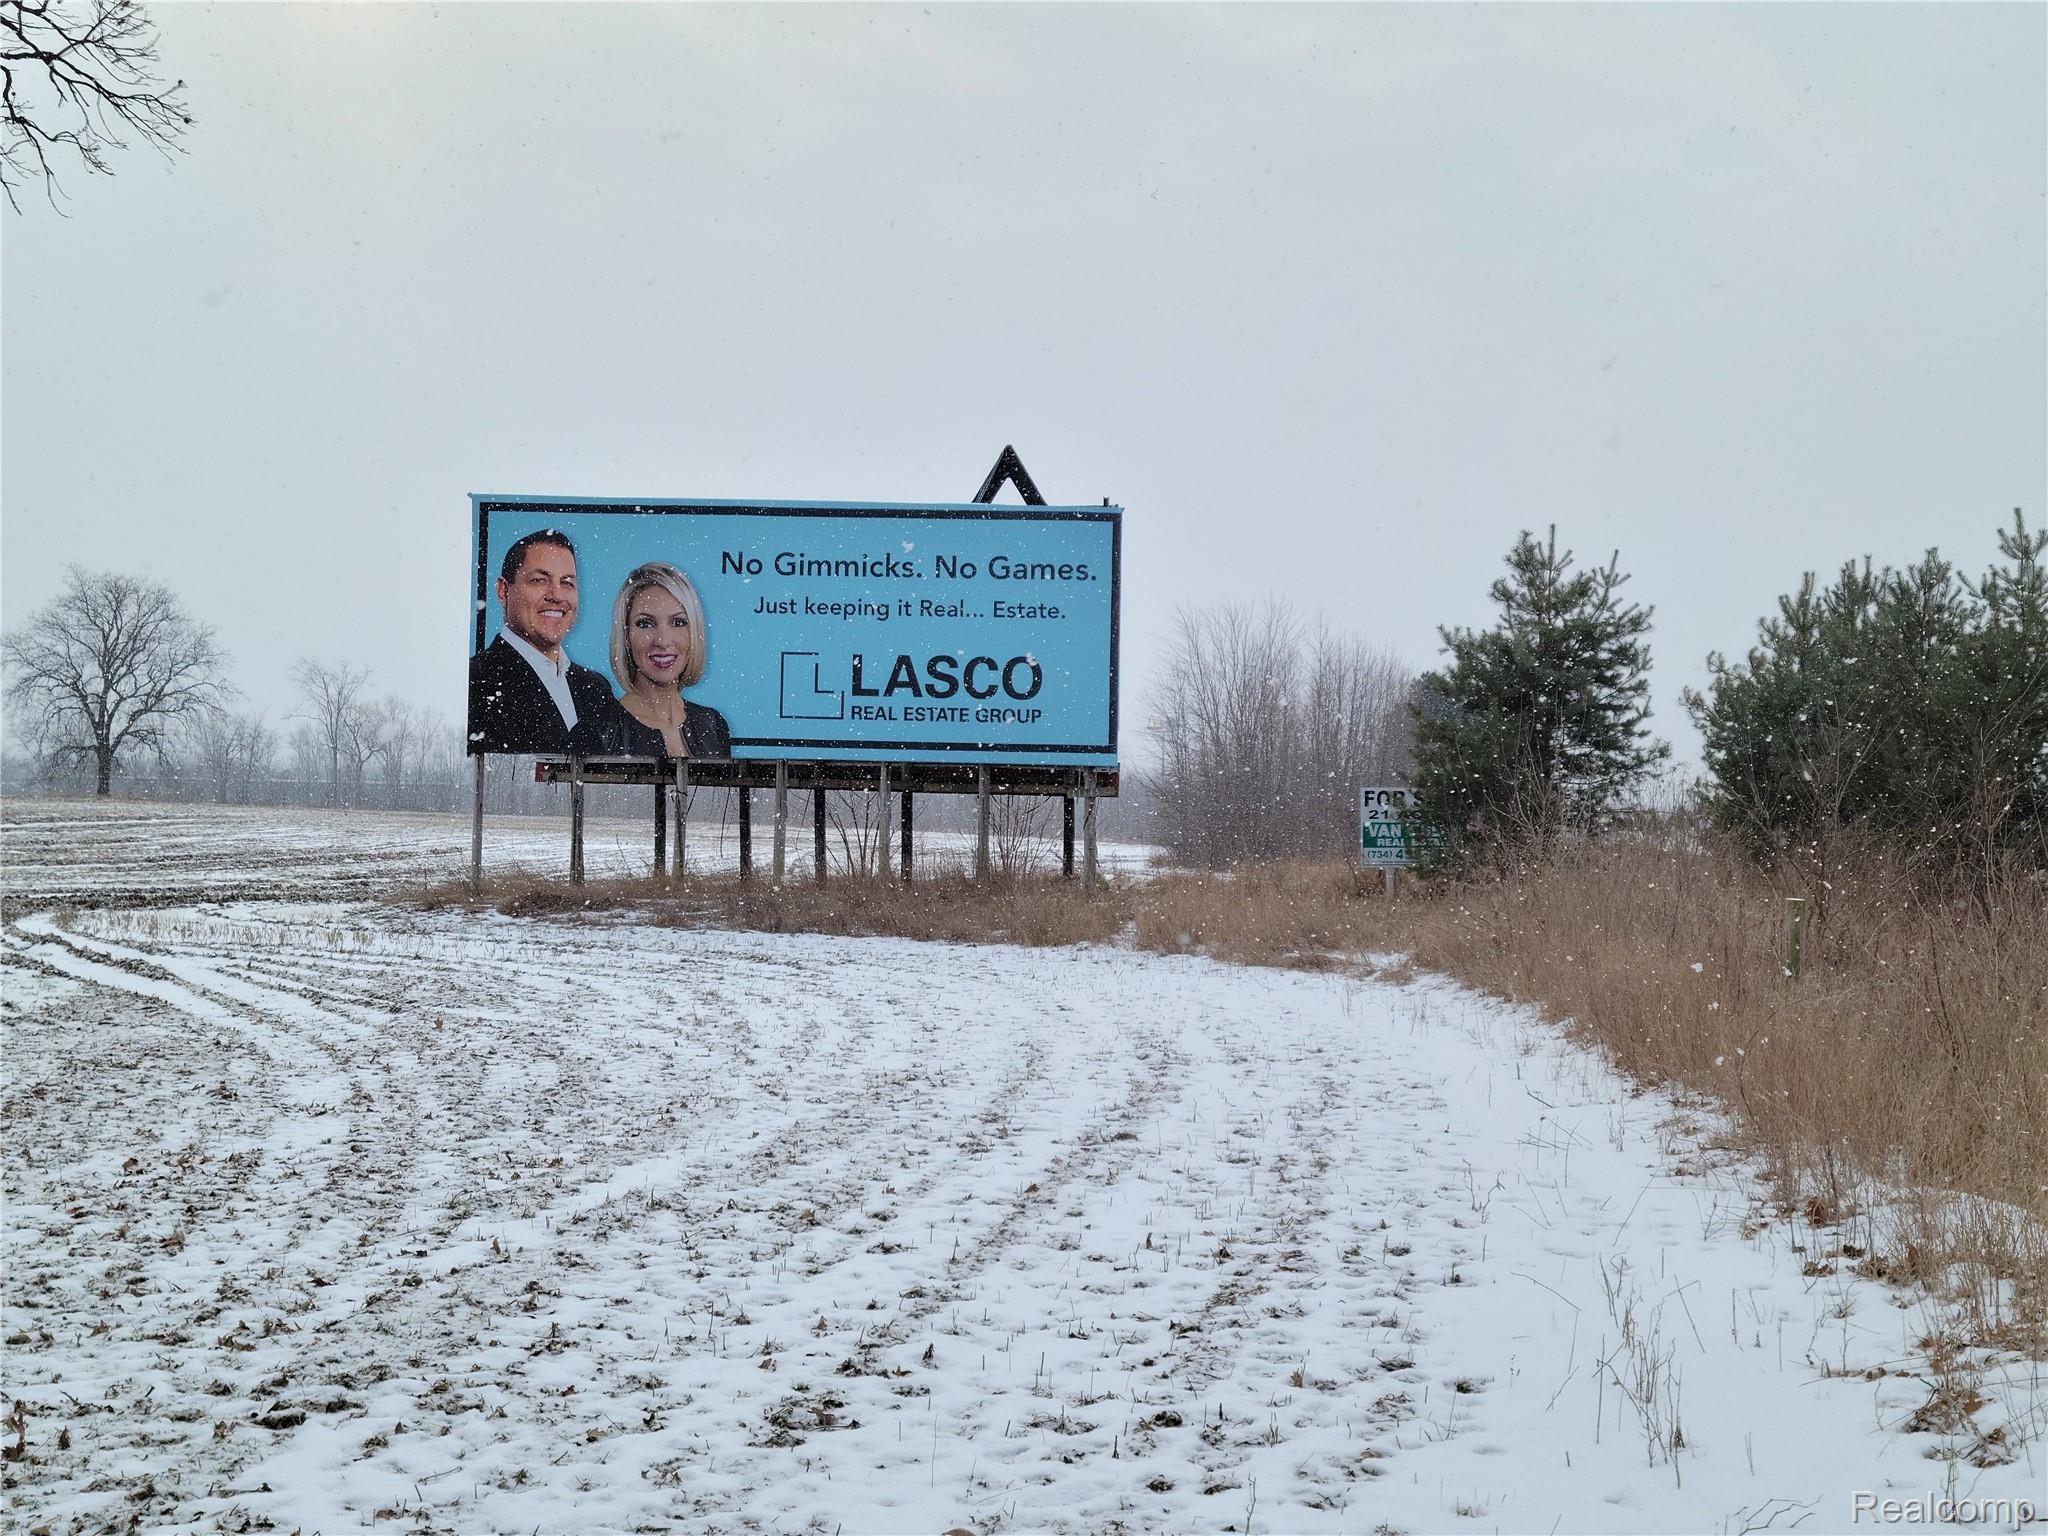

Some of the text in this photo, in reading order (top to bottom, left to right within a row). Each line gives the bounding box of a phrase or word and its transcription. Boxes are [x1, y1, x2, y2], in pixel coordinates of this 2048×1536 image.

[721, 551, 1097, 581] No Gimmicks. No Games.
[753, 596, 1066, 622] Just keeping it Real... Estate.
[851, 653, 1043, 701] LASCO
[851, 705, 1042, 724] REAL ESTATE GROUP
[1369, 823, 1402, 838] VAN
[1367, 850, 1393, 859] (734)
